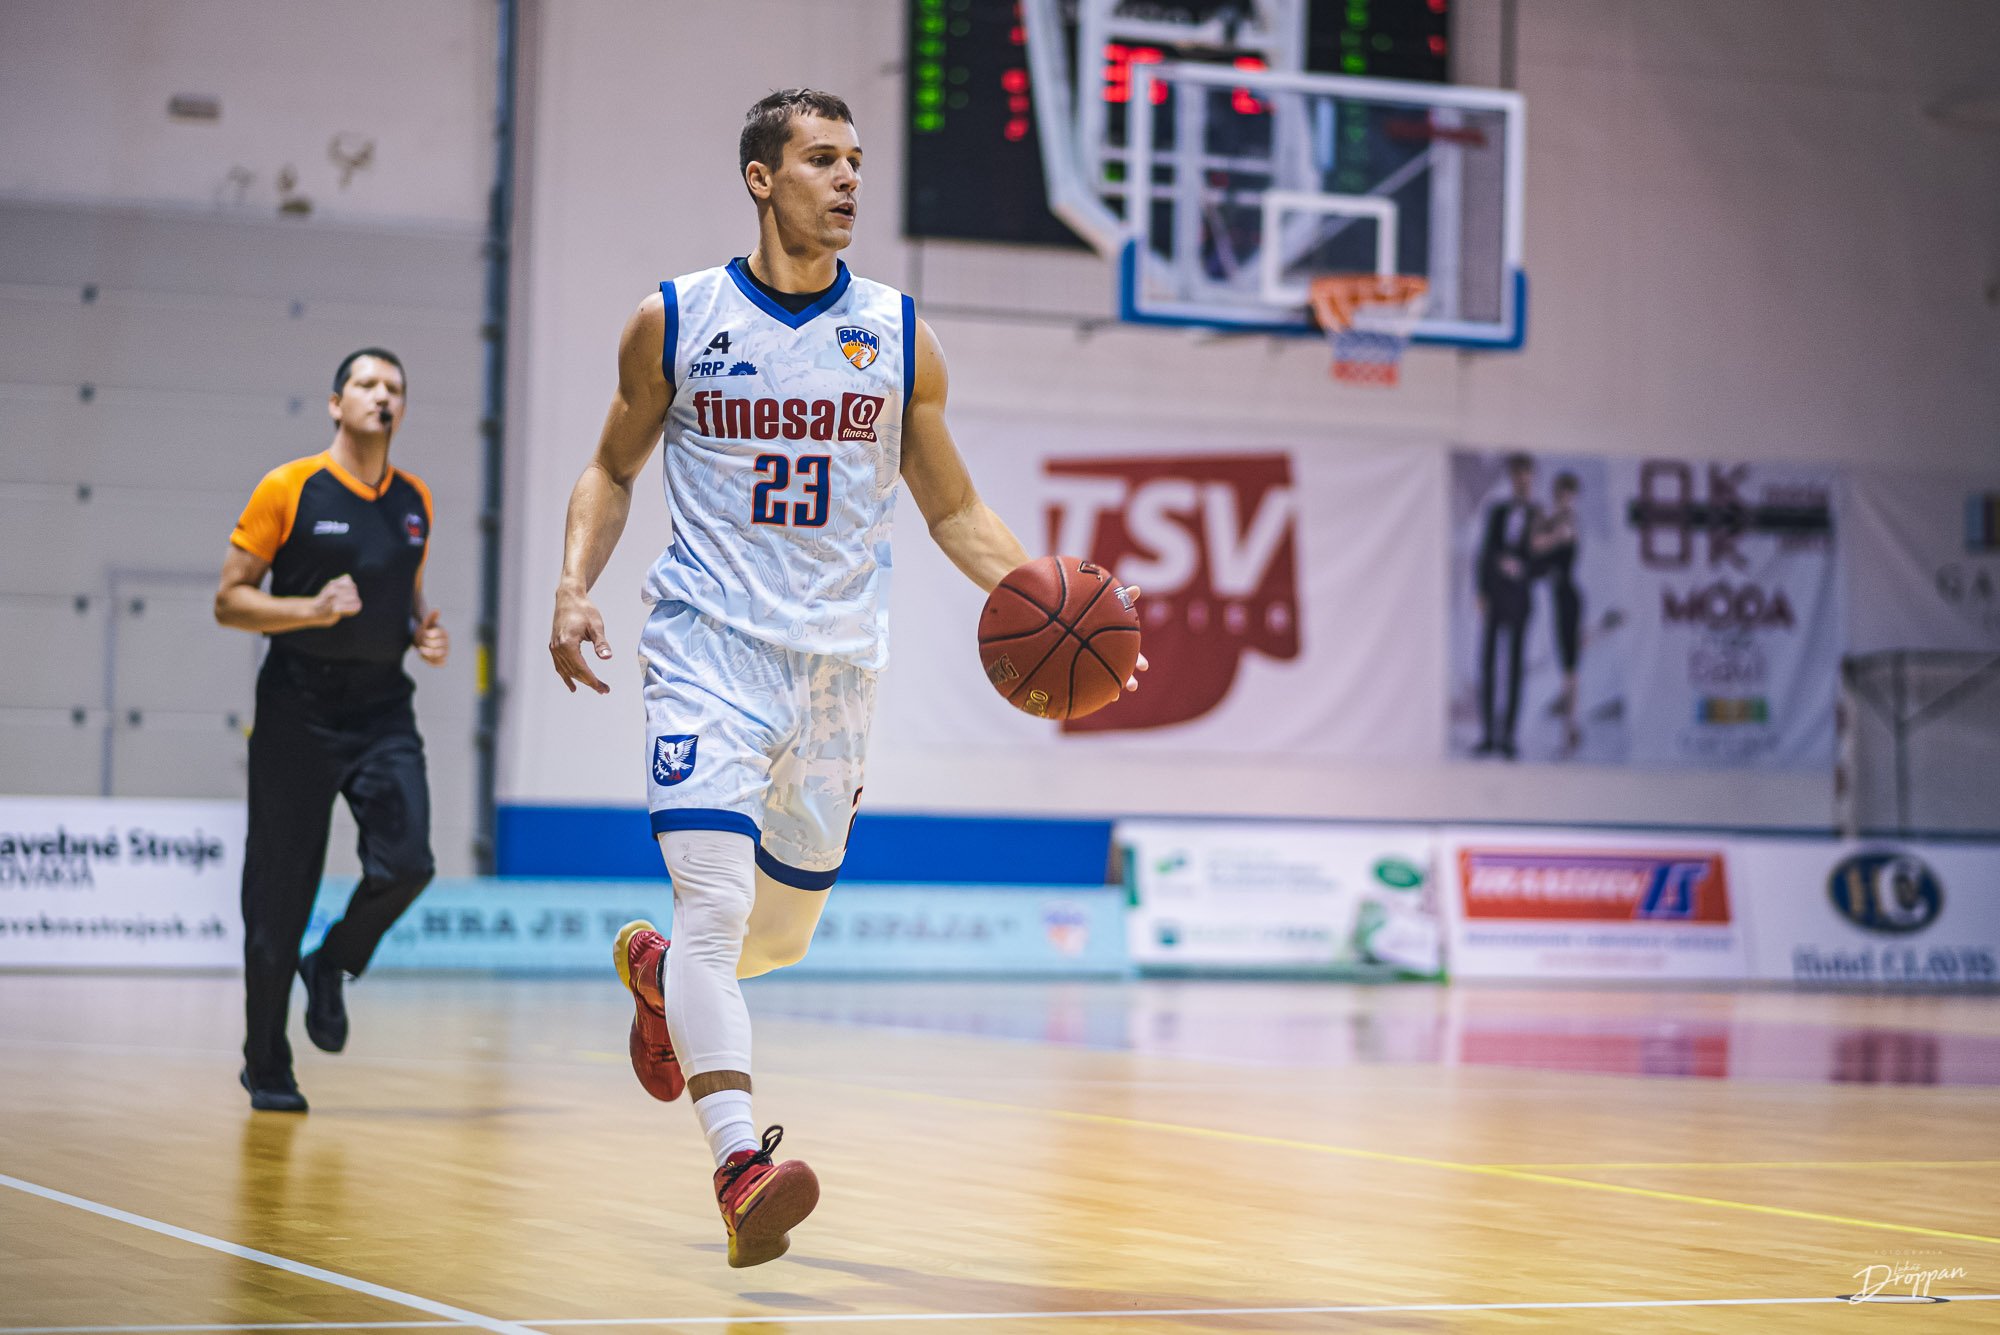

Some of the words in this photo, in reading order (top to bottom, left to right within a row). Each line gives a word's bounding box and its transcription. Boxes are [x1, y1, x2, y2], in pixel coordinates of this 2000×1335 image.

[840, 329, 878, 350] BKM
[689, 361, 725, 378] PRP
[693, 390, 835, 441] finesa
[842, 428, 874, 440] finesa
[751, 453, 832, 528] 23
[1038, 478, 1298, 597] TSV
[128, 827, 224, 873] Stroje
